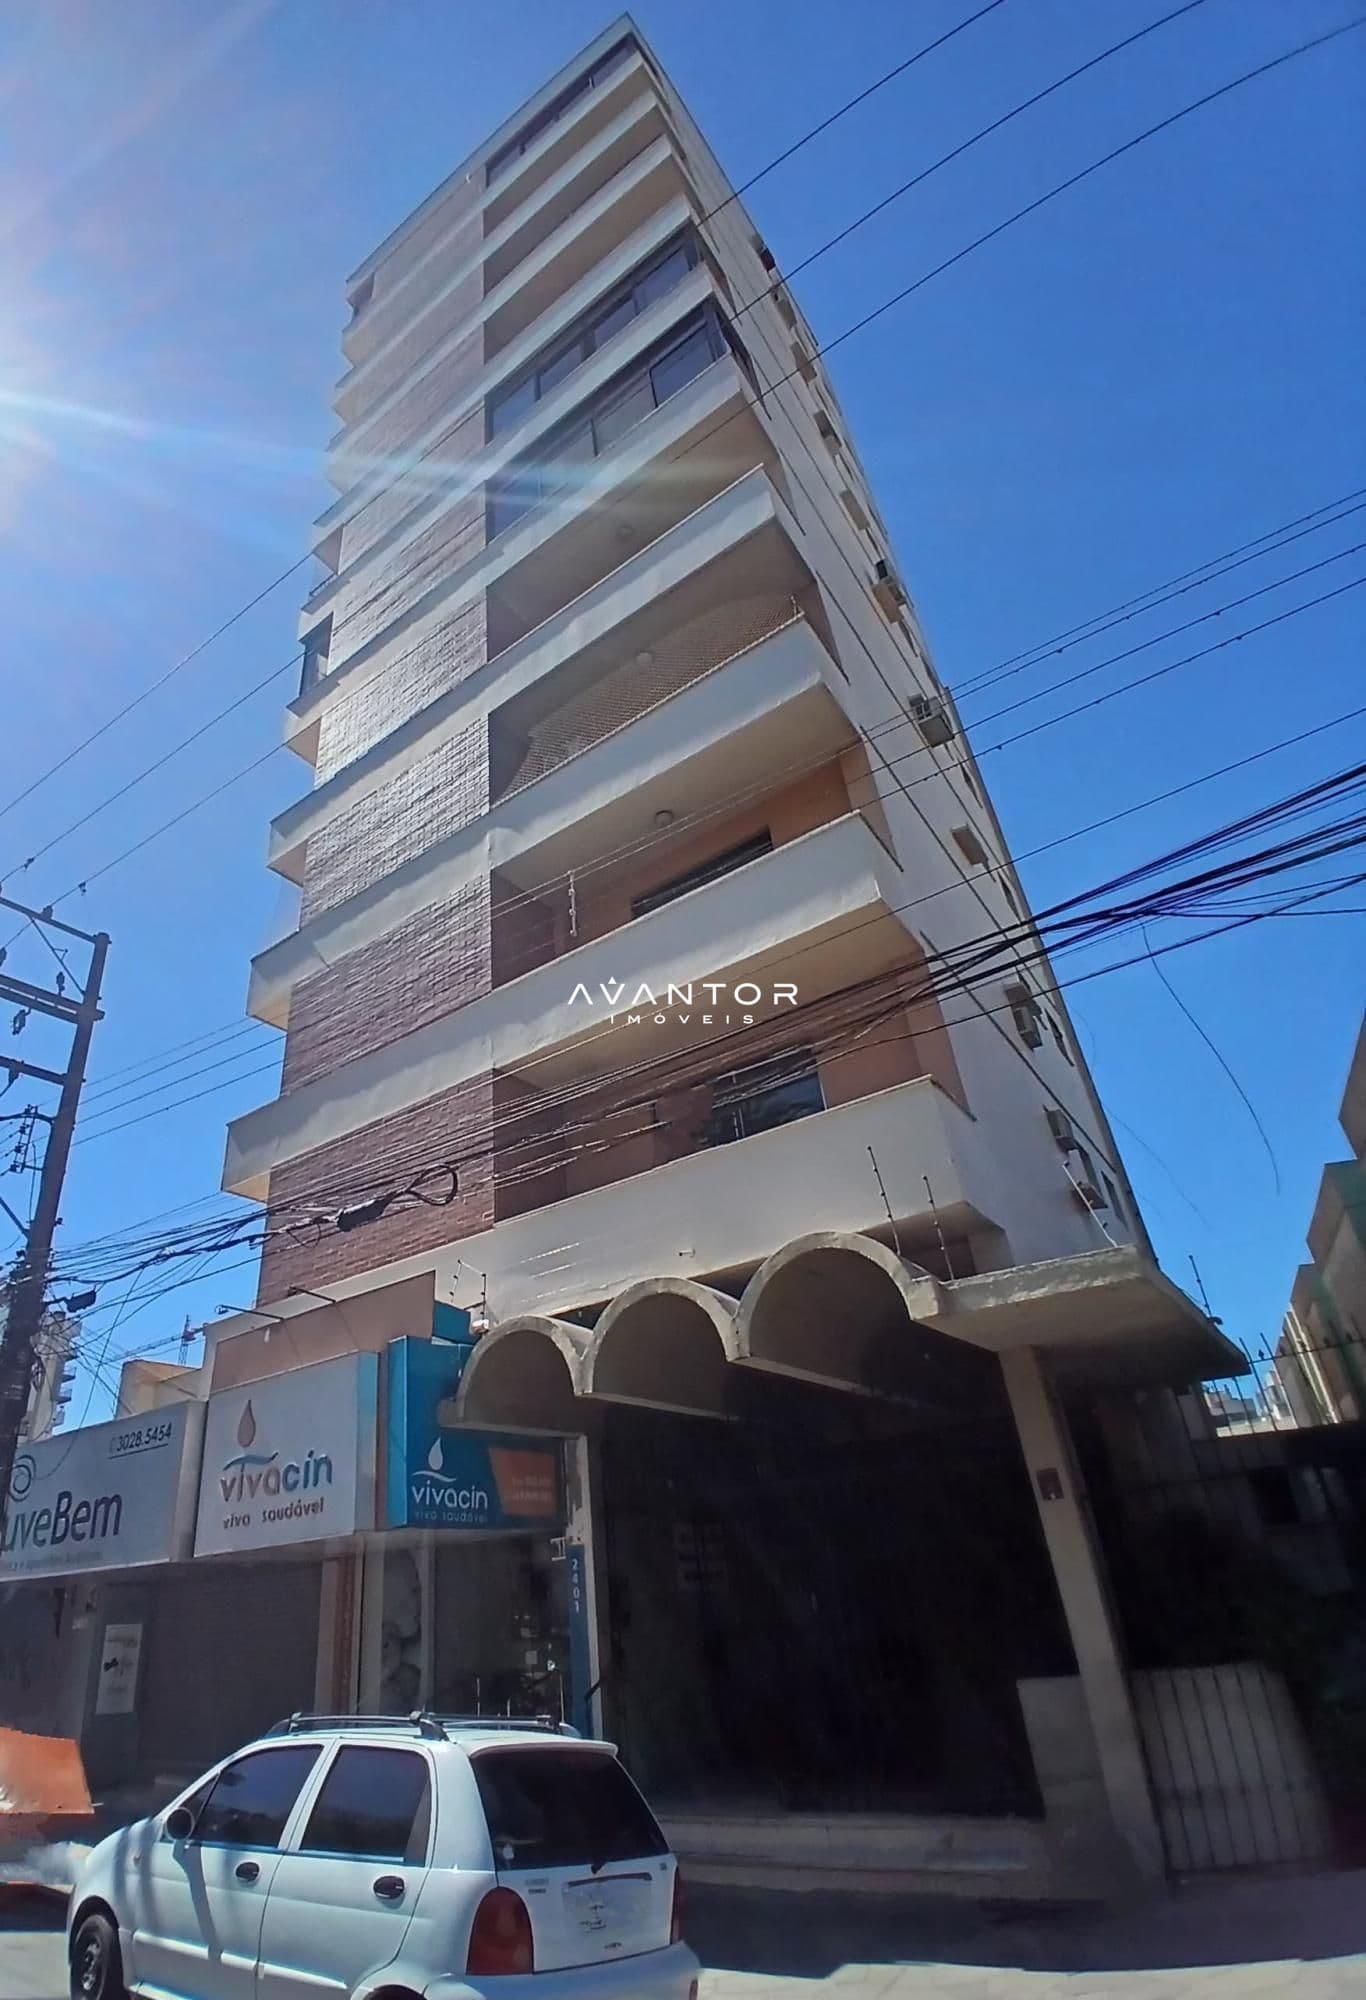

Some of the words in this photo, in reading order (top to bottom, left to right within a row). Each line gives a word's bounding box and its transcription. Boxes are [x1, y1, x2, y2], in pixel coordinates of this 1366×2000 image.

[220, 1449, 333, 1503] vivacin
[262, 1496, 324, 1523] saudável
[411, 1479, 488, 1510] vivacin
